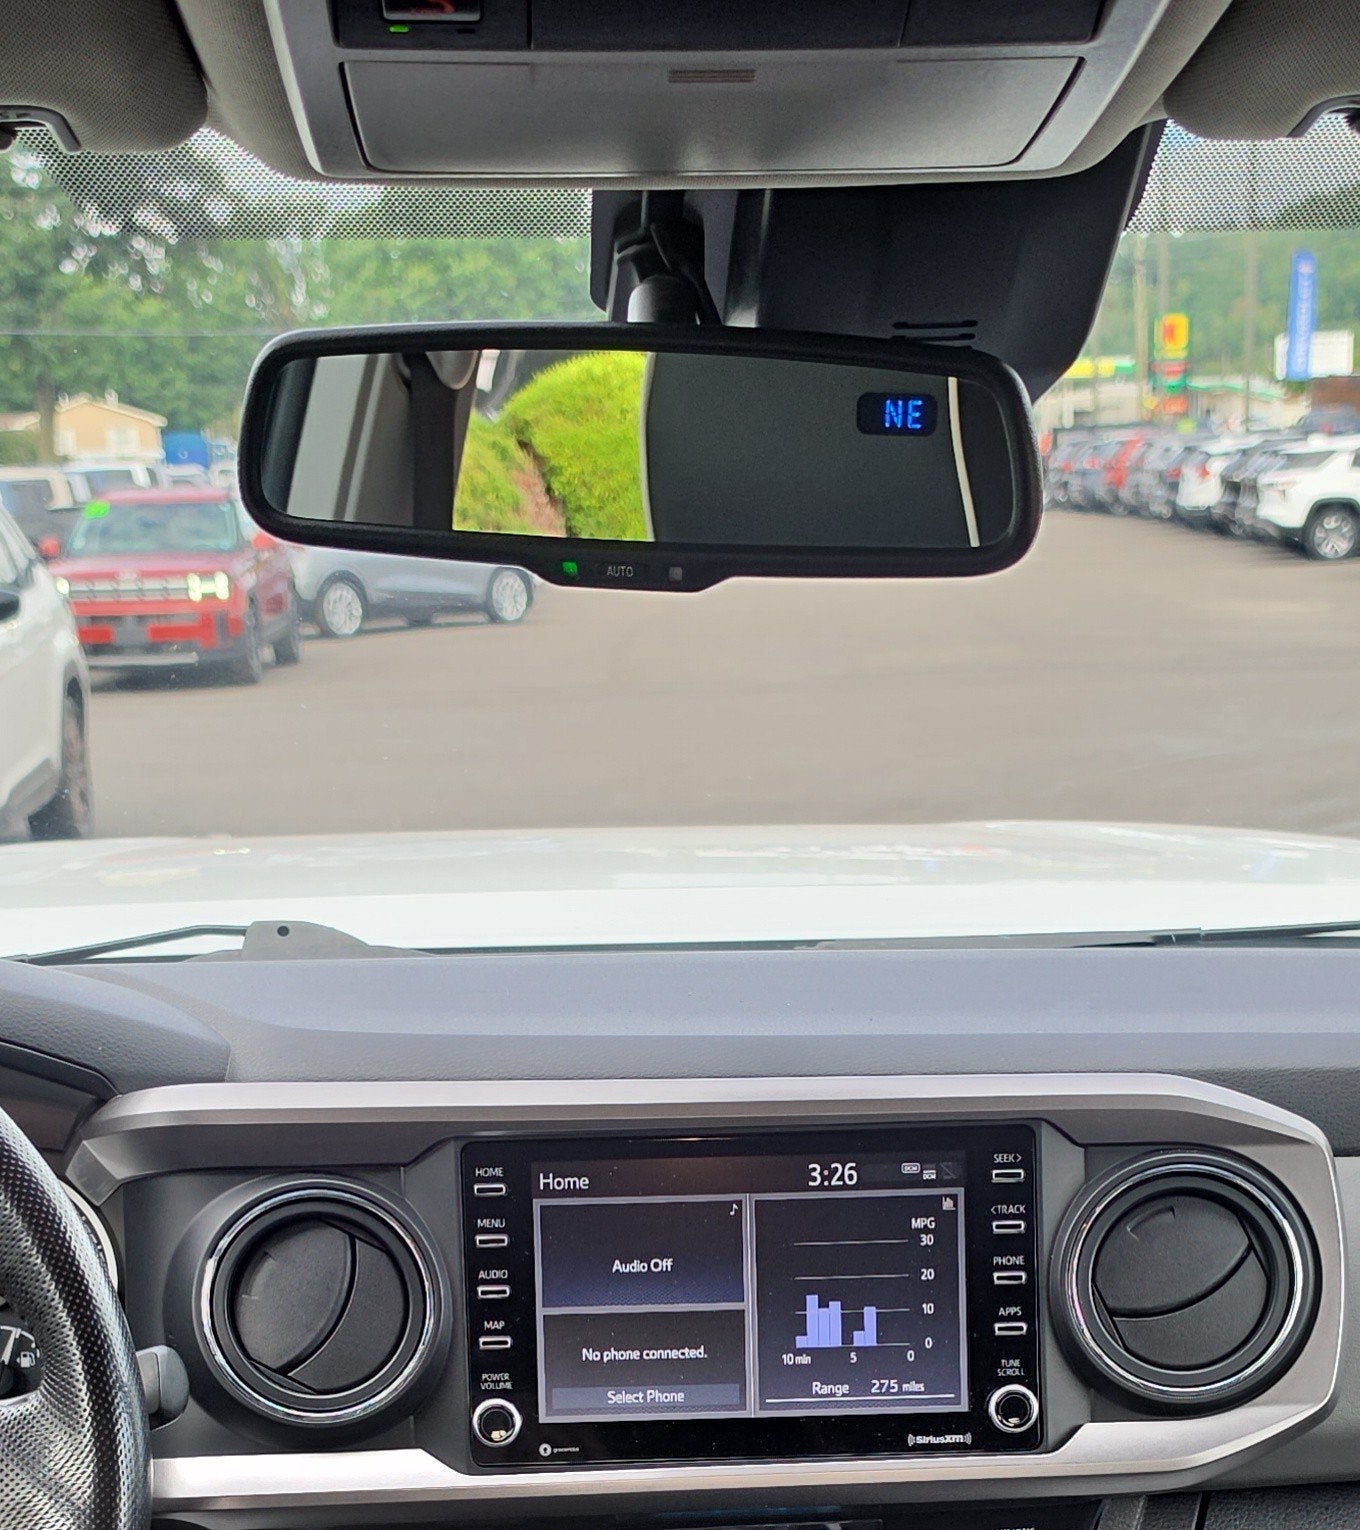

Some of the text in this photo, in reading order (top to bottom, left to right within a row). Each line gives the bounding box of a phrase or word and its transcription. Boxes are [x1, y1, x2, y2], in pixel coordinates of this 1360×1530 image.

[885, 399, 924, 430] NE
[606, 565, 634, 578] AUTO
[475, 1167, 504, 1177] HOME
[539, 1163, 857, 1191] Home 3:26
[477, 1218, 505, 1228] MENU
[910, 1217, 936, 1230] MPG
[919, 1235, 934, 1247] 30
[612, 1257, 674, 1273] Audio Off
[993, 1256, 1024, 1266] PHONE
[478, 1269, 508, 1279] AUDIO
[920, 1269, 935, 1281] 20
[921, 1304, 935, 1316] 10
[999, 1307, 1021, 1317] APPS
[484, 1320, 504, 1330] MAP
[924, 1338, 933, 1350] 0
[581, 1346, 708, 1365] No phone connected.
[781, 1354, 812, 1366] 10 min
[849, 1352, 857, 1365] 5
[907, 1350, 915, 1363] 0
[1001, 1359, 1020, 1368] TUNE
[481, 1373, 510, 1382] POWER
[997, 1367, 1024, 1377] SCROLL
[480, 1381, 512, 1391] VOLUME
[812, 1379, 925, 1397] Range 275 miles
[607, 1388, 685, 1404] Select Phone
